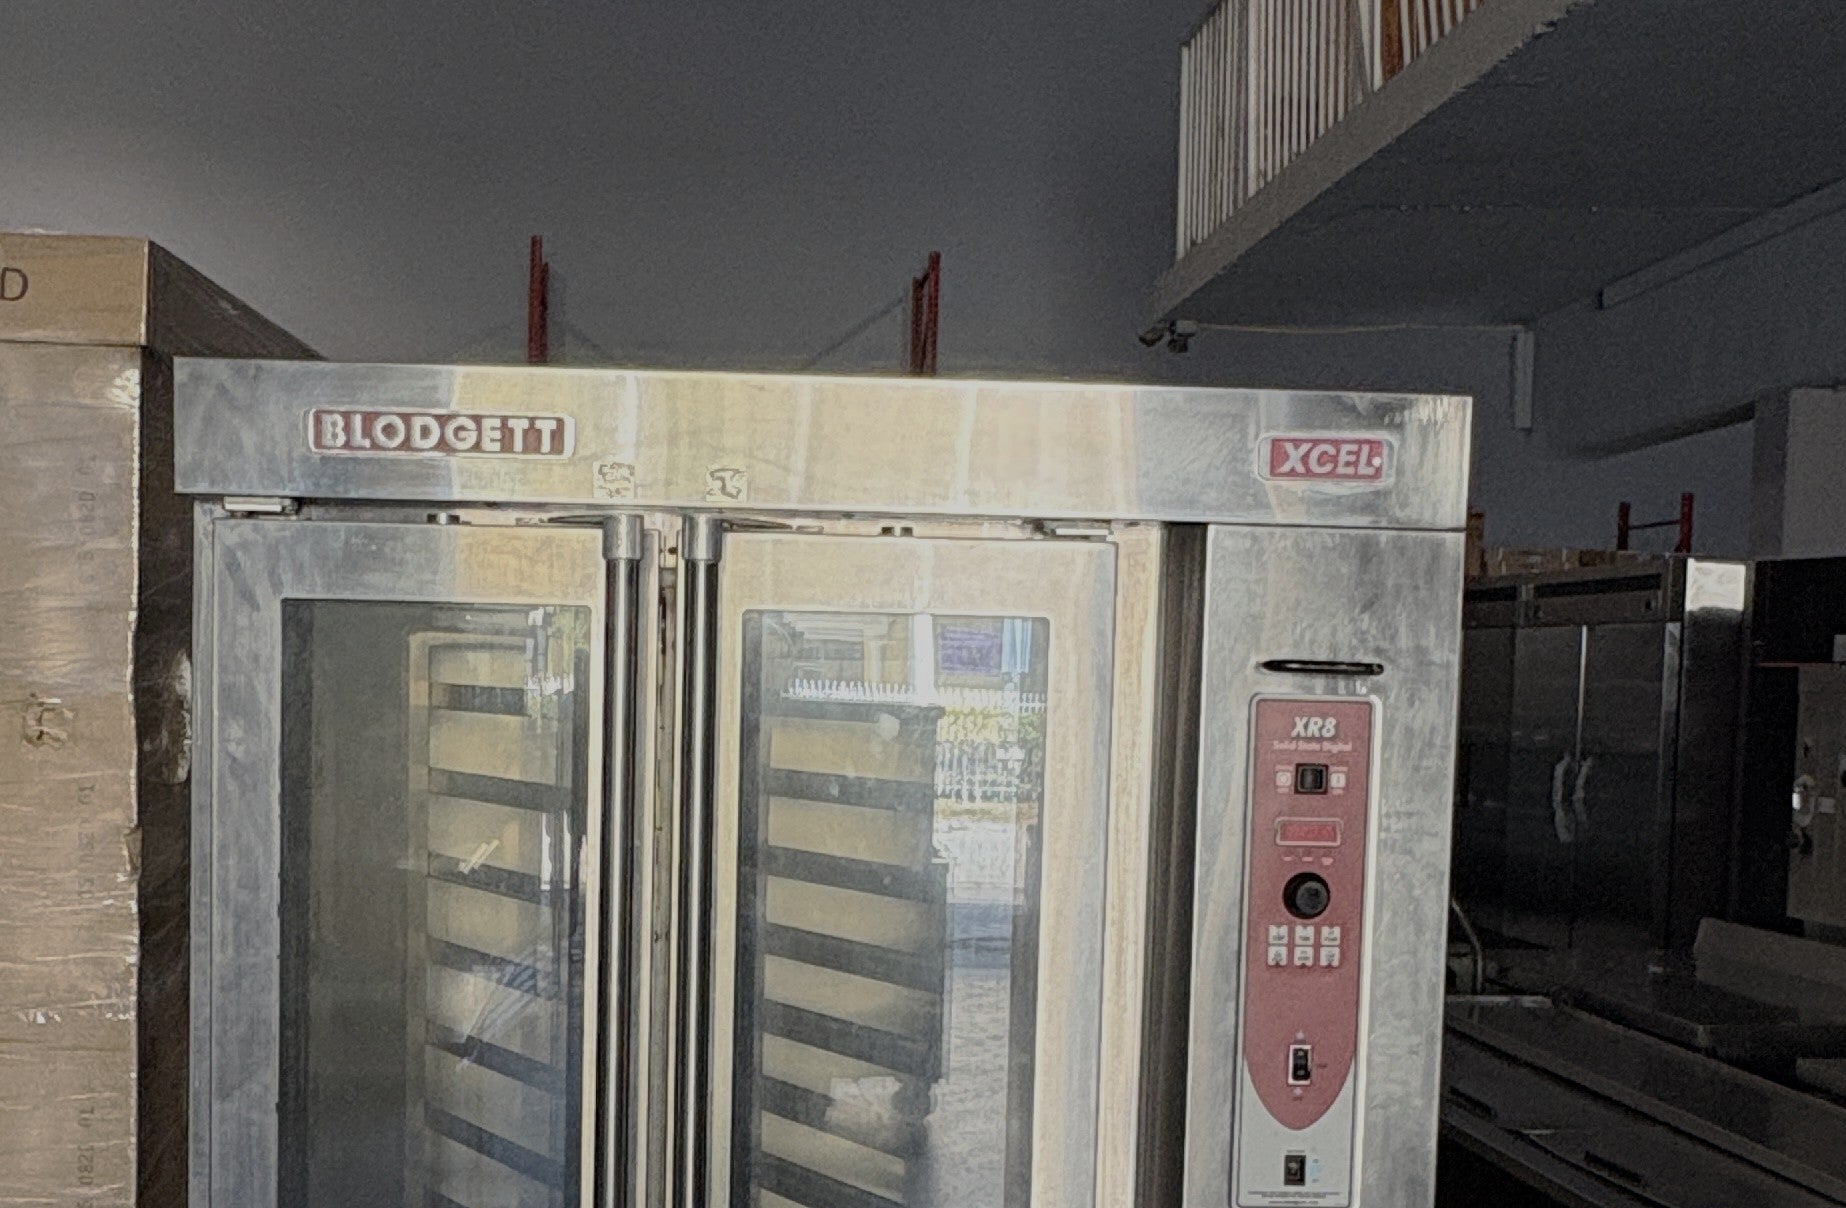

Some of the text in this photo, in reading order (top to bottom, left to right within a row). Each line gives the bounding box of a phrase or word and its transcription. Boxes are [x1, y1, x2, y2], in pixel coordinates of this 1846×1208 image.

[0, 266, 28, 301] D
[321, 413, 557, 453] BLODGETT
[1290, 716, 1337, 738] XR8
